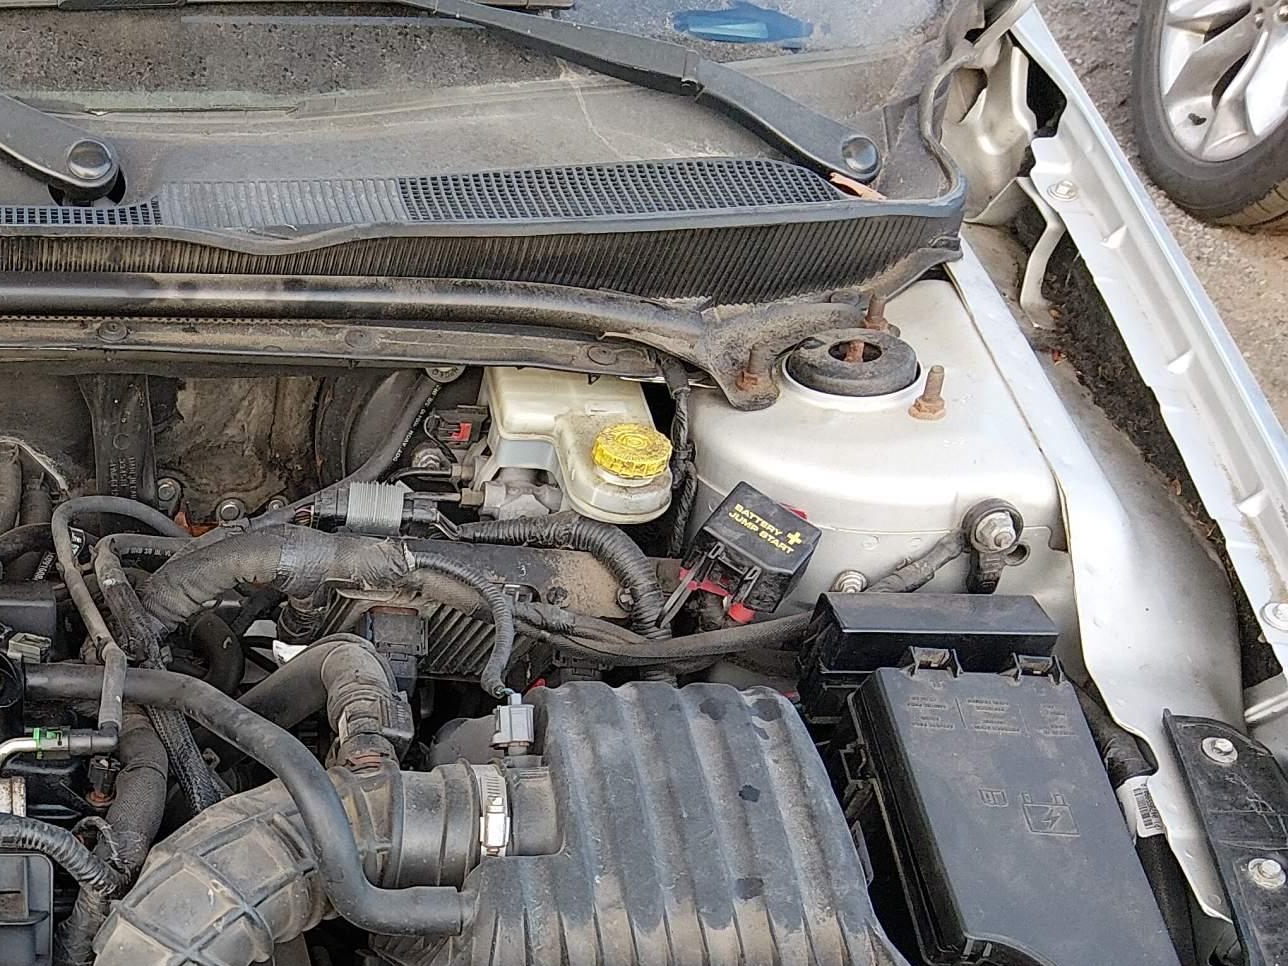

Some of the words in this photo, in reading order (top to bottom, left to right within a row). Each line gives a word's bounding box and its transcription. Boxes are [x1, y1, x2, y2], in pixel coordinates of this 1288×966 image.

[728, 511, 760, 532] JUMP
[758, 529, 795, 554] START
[734, 503, 784, 536] BATTERY
